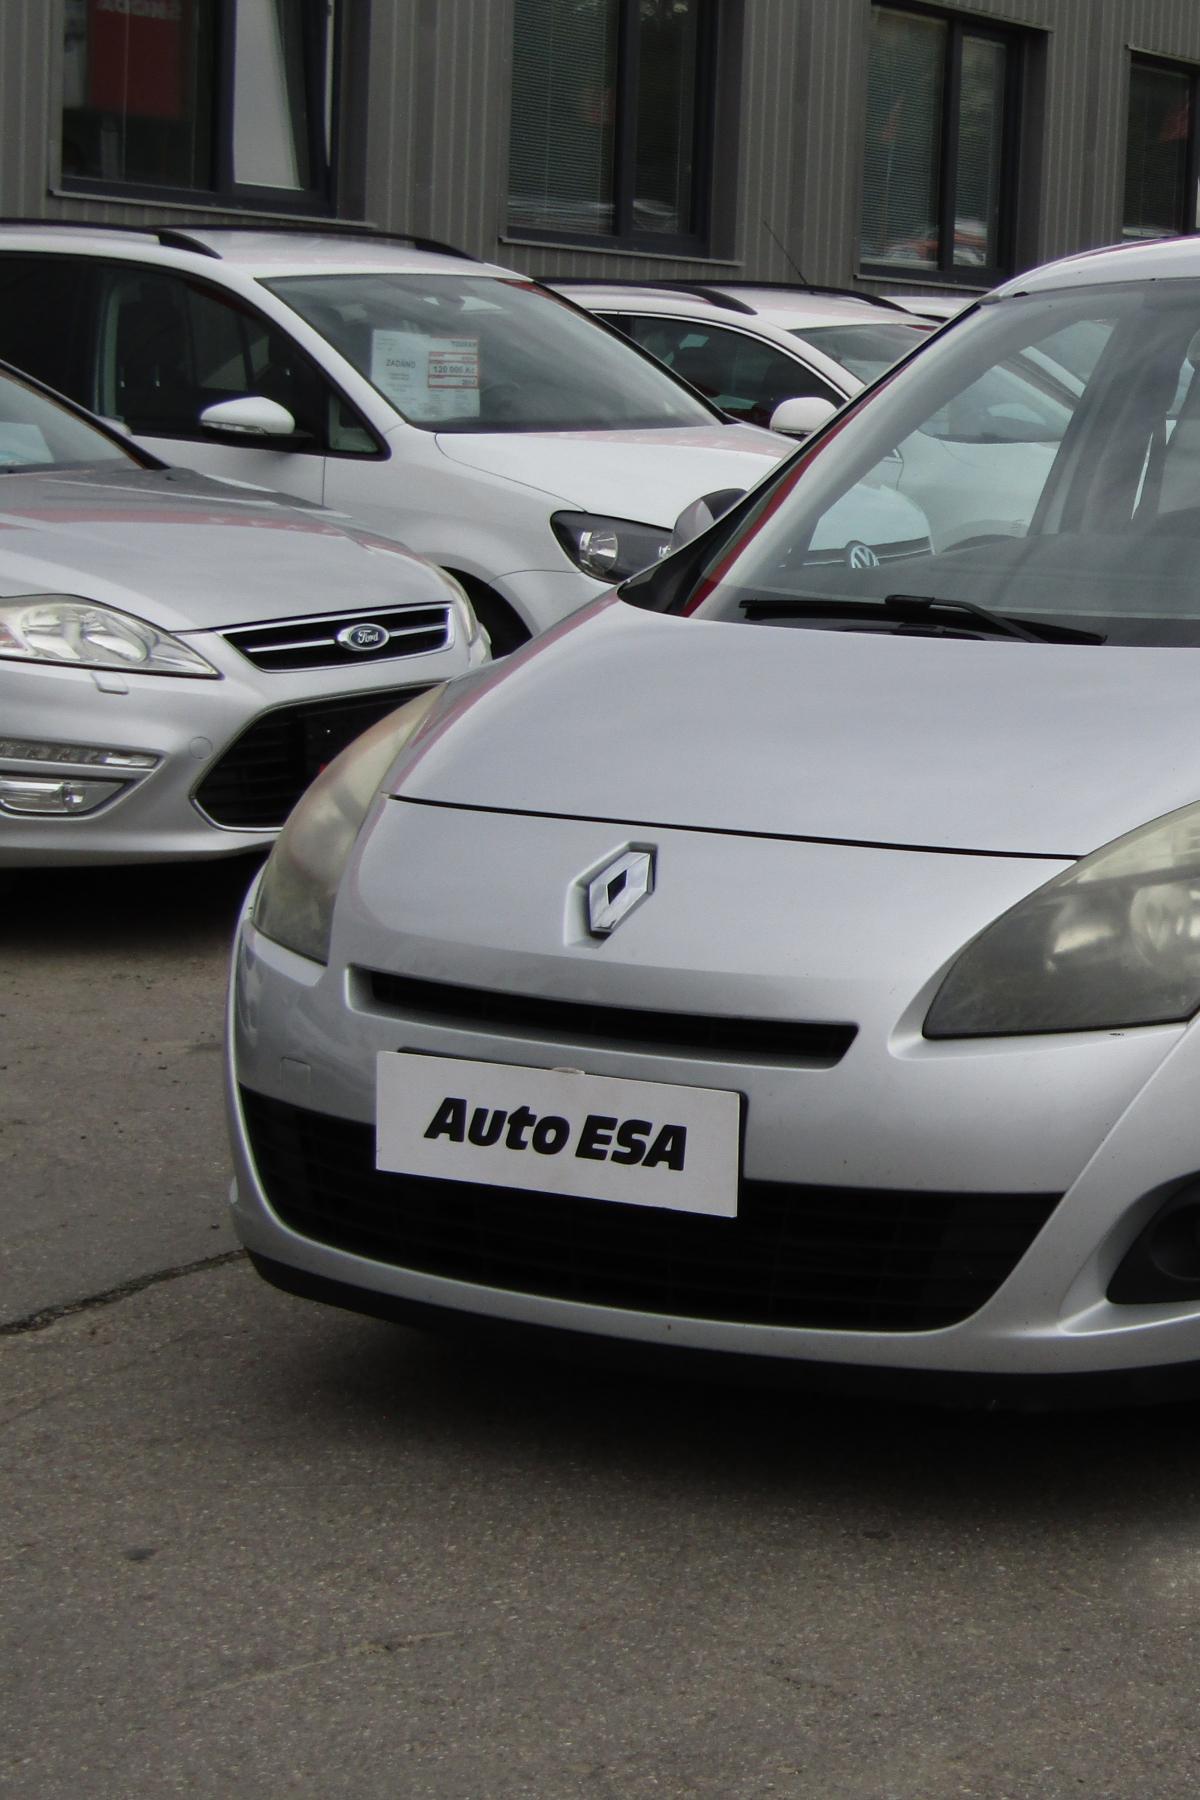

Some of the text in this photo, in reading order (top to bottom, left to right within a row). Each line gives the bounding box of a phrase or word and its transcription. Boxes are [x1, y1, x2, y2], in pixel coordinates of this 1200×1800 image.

[357, 629, 379, 644] Ford
[423, 1096, 687, 1171] Auto ESA
